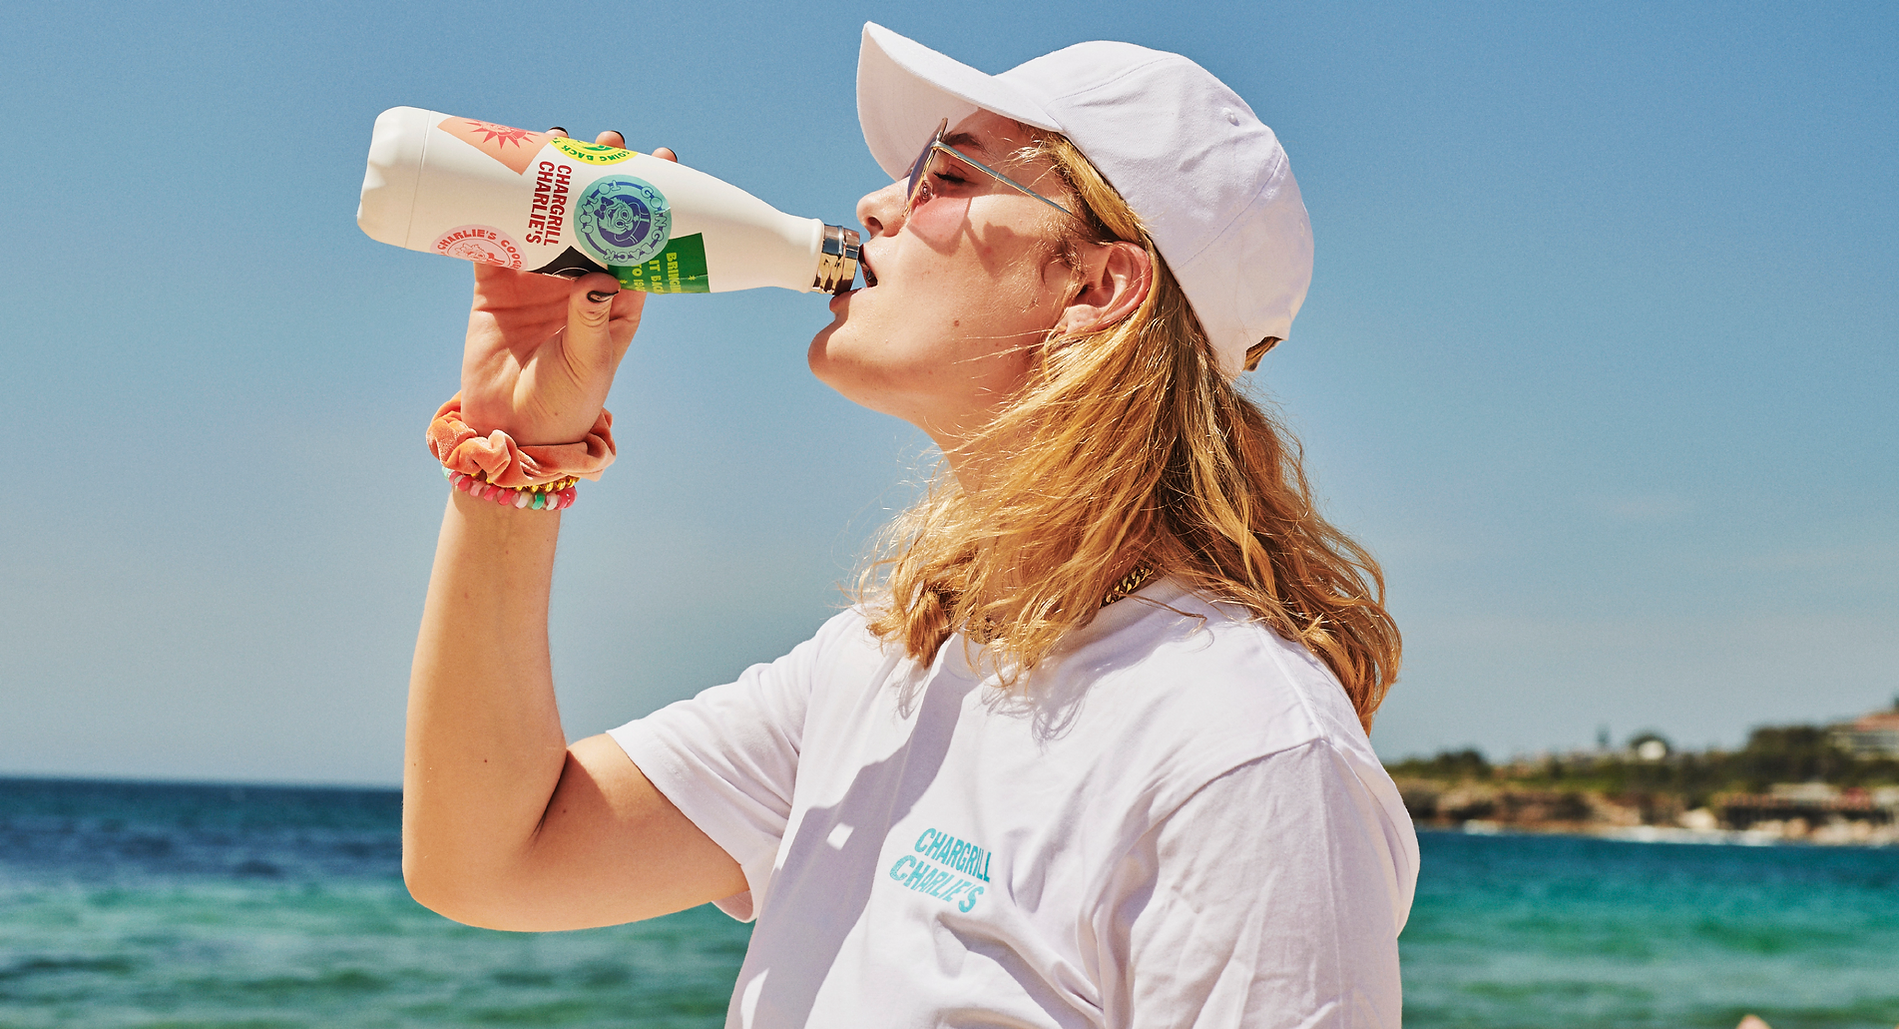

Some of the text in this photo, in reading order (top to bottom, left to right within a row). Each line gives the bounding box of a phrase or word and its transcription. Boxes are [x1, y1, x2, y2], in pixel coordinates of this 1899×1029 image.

[561, 145, 594, 161] BACK
[525, 161, 555, 244] CHARLIE'S
[543, 165, 572, 246] CHARGRILL
[597, 179, 622, 195] TO
[437, 228, 497, 250] CHARLIE'S
[603, 186, 668, 263] GOING BACK
[648, 259, 661, 272] IT
[914, 827, 992, 883] CHARGRILL
[889, 854, 985, 913] CHARLIE'S
